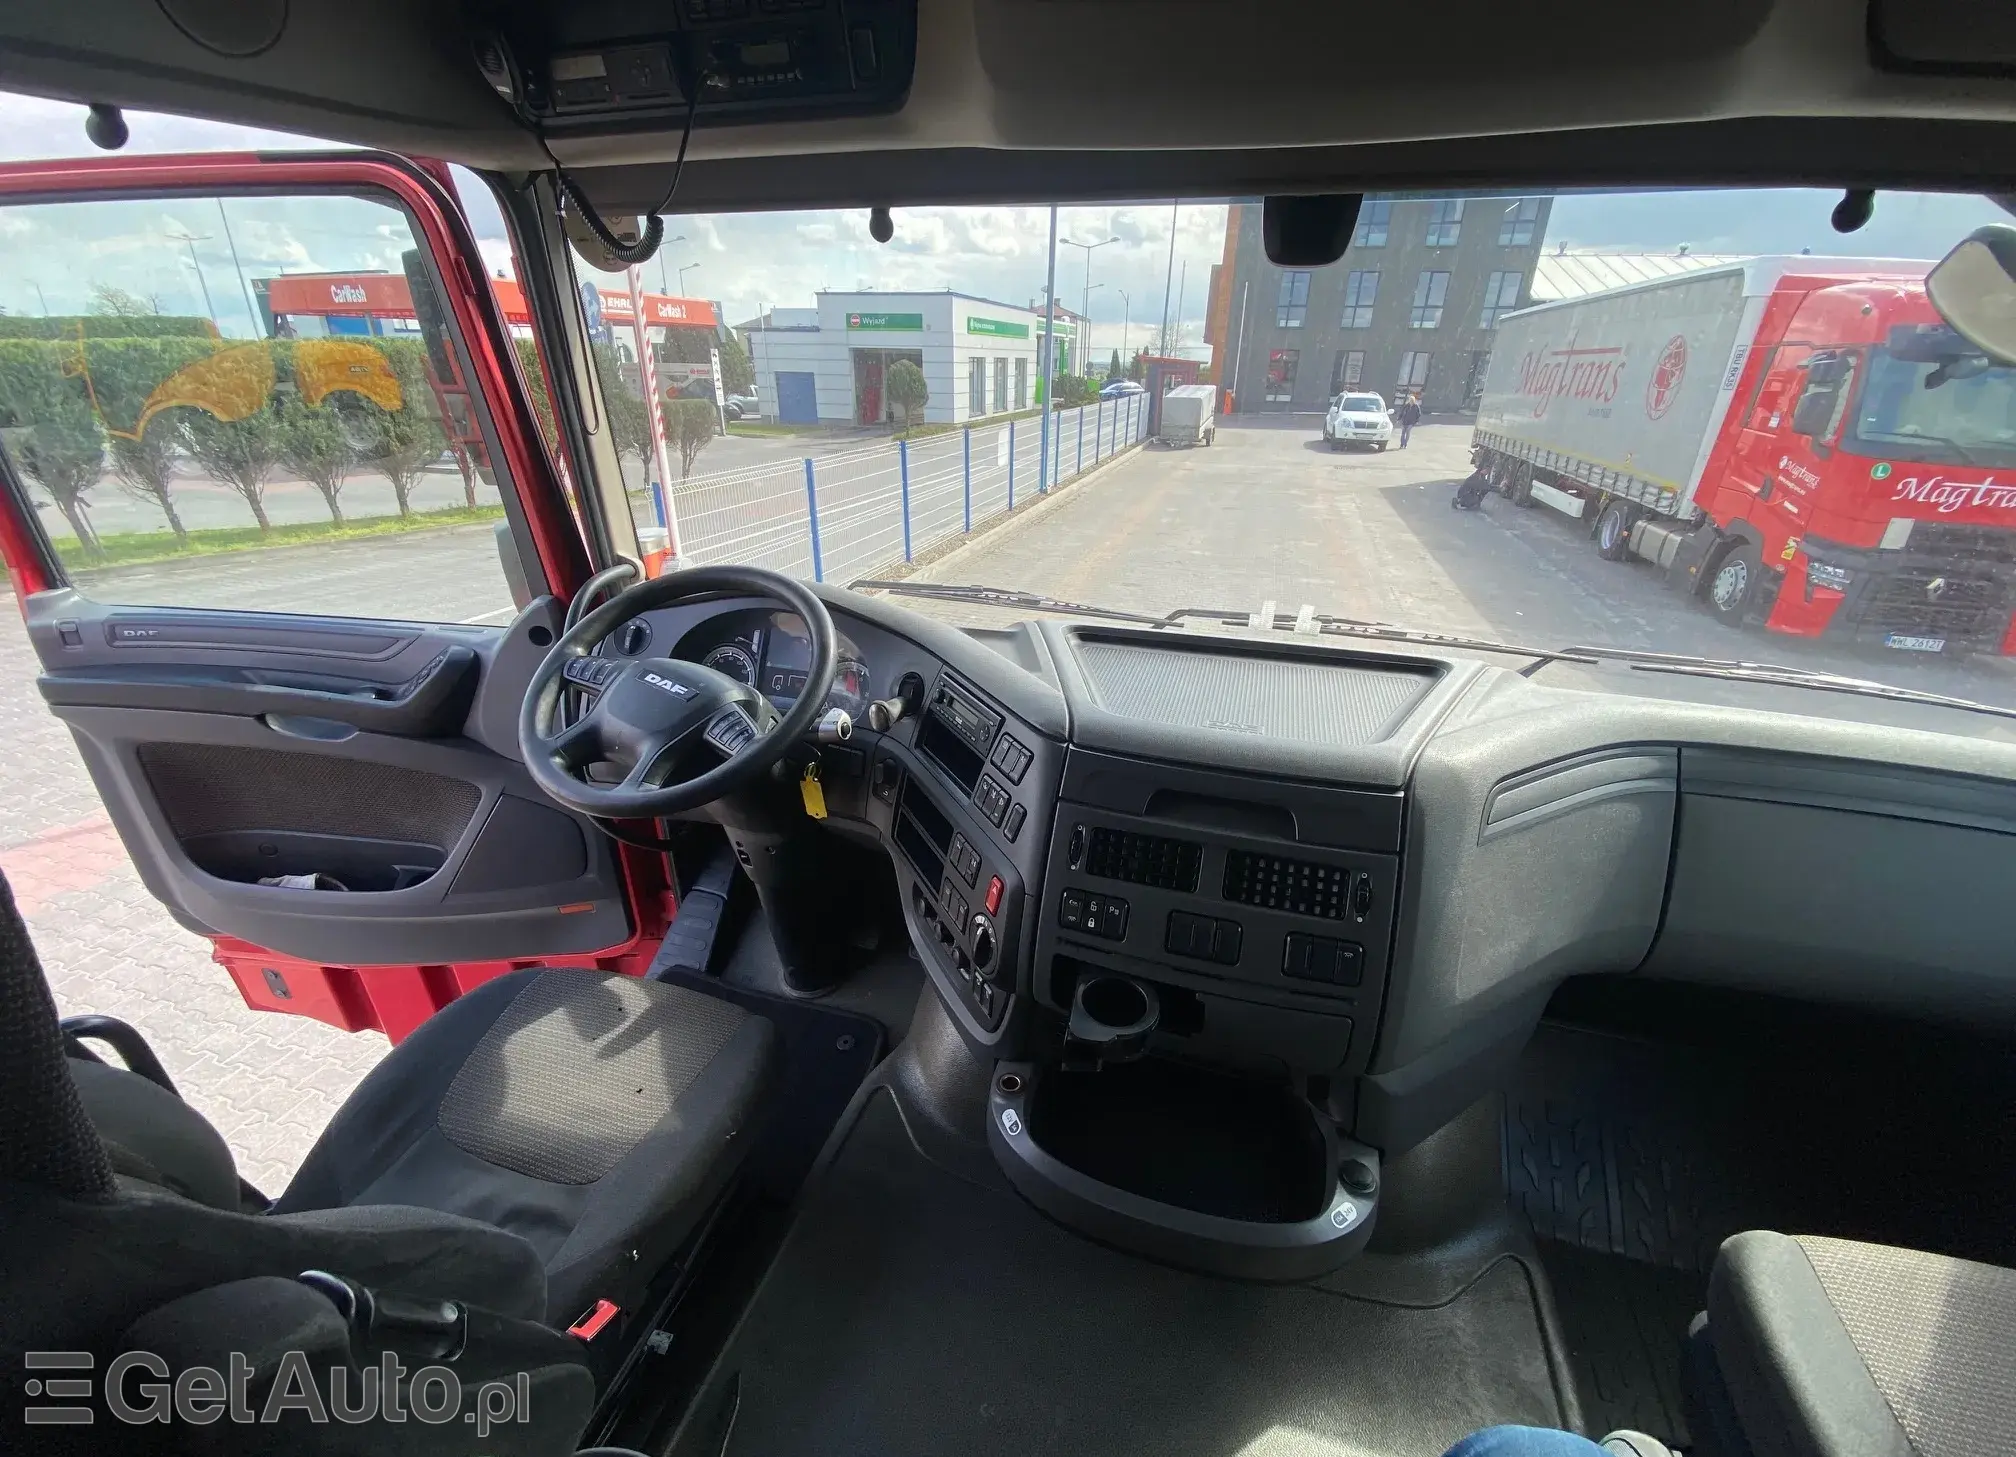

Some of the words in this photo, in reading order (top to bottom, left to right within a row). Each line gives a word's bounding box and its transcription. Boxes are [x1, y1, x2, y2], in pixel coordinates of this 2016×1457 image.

[331, 284, 367, 303] CarWash
[607, 296, 634, 308] EHRL
[1515, 328, 1627, 418] Magtrans
[1877, 467, 1886, 477] L
[644, 673, 688, 694] DAF
